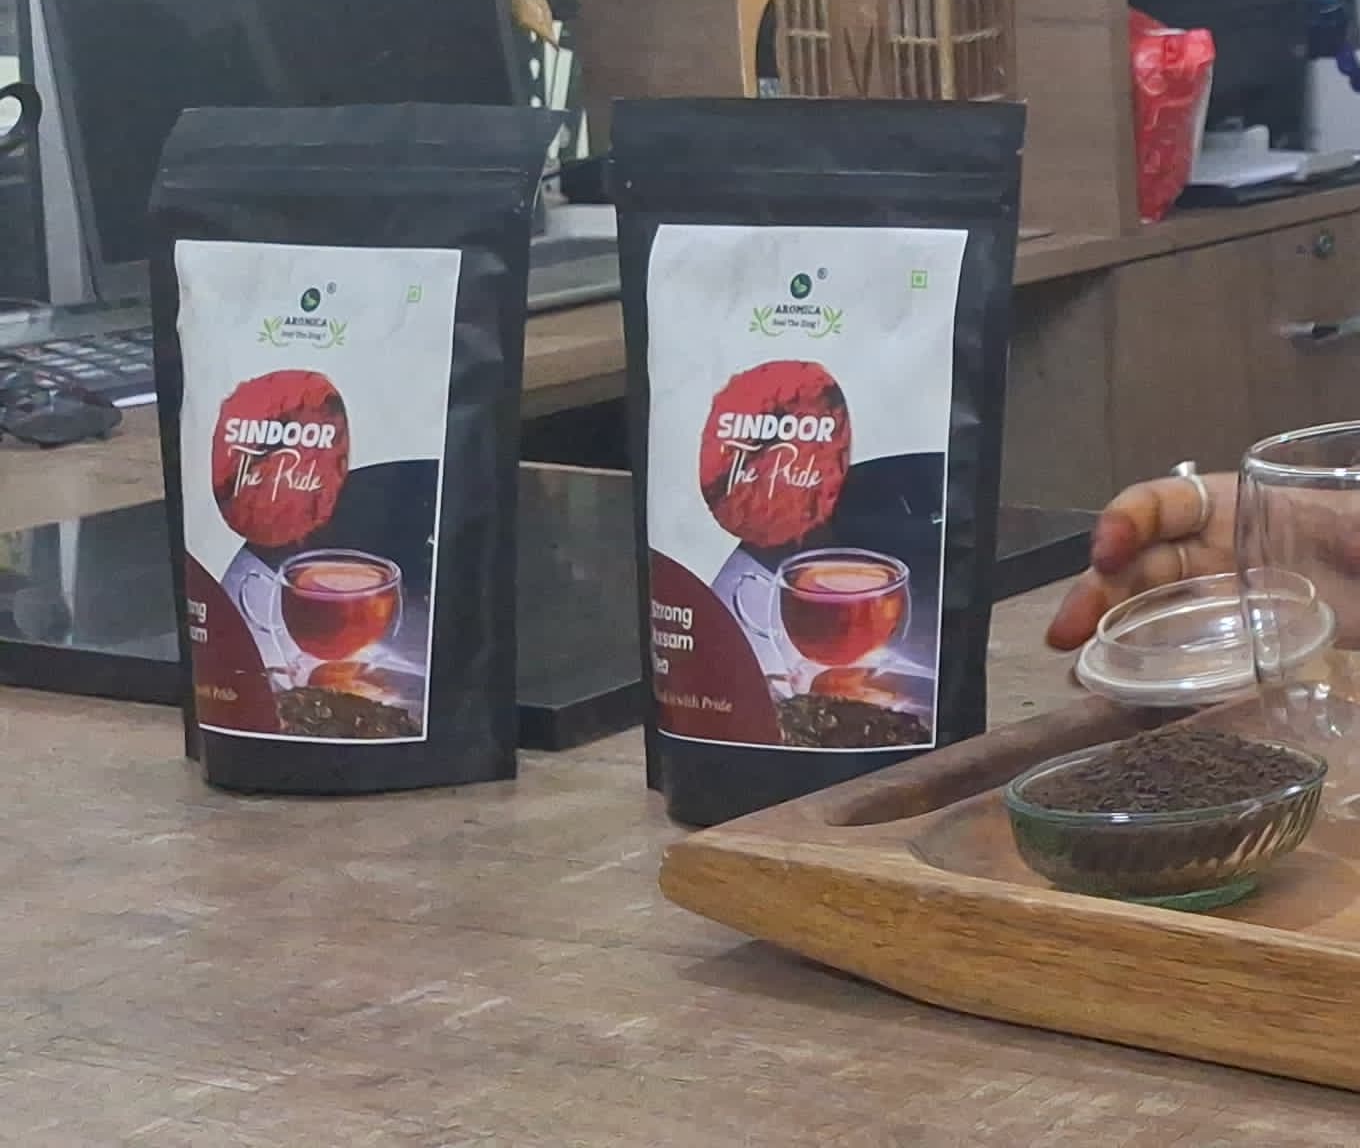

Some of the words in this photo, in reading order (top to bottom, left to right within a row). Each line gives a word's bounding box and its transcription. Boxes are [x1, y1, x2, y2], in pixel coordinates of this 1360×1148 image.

[775, 305, 820, 315] AROMICA
[224, 418, 336, 449] SINDOOR
[717, 412, 836, 442] SINDOOR
[228, 445, 267, 498] The
[720, 440, 761, 495] The
